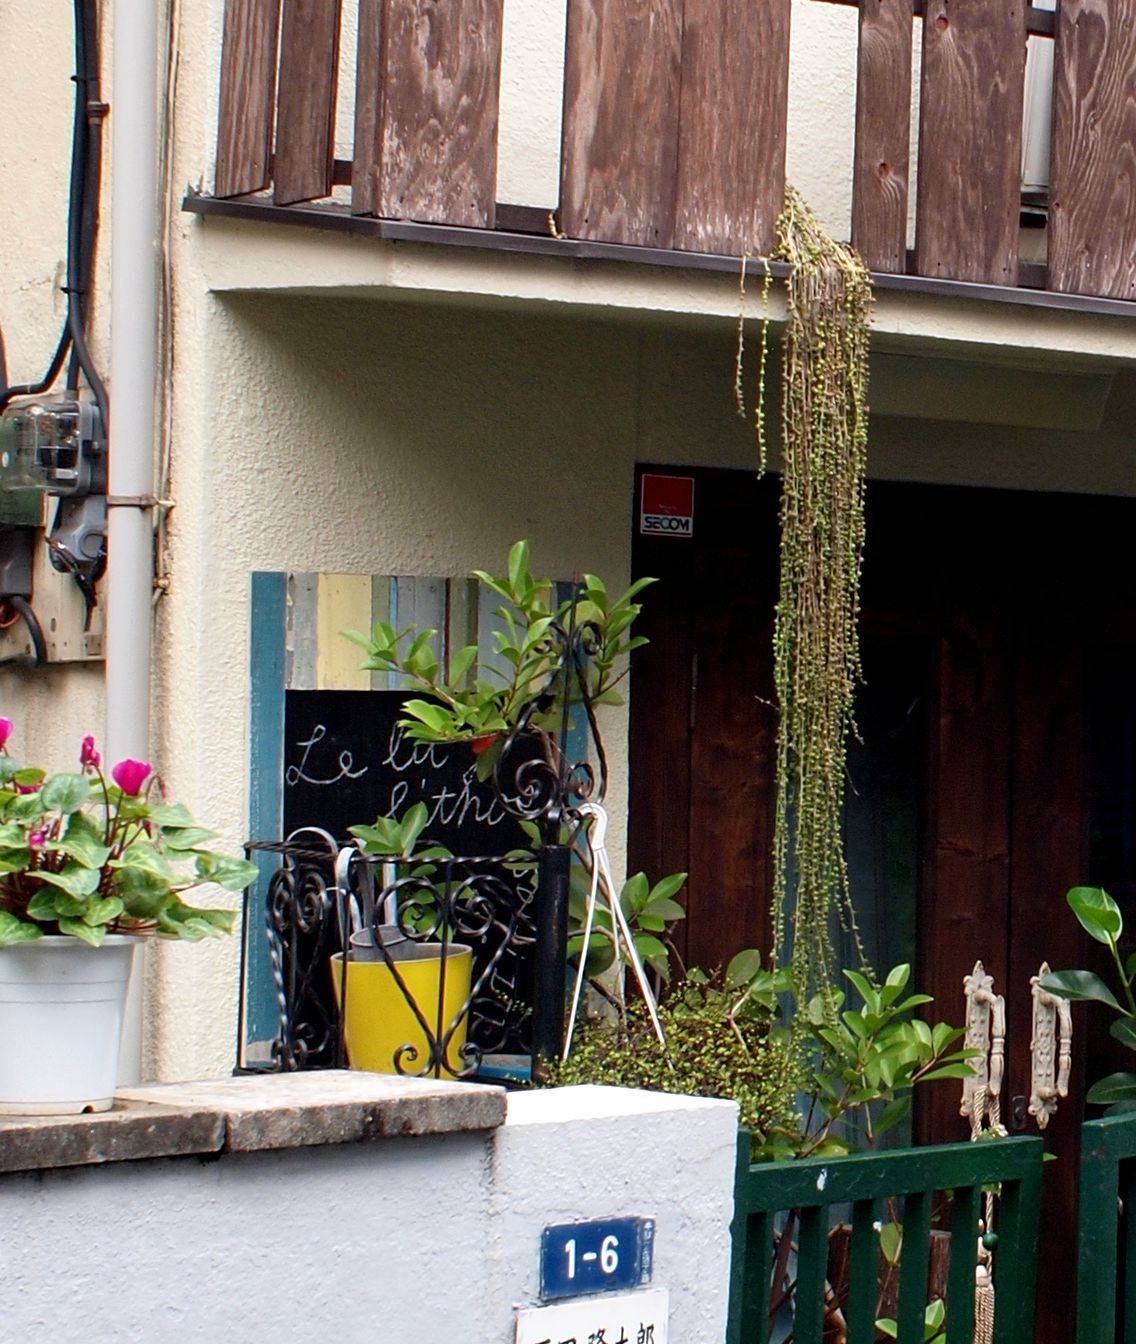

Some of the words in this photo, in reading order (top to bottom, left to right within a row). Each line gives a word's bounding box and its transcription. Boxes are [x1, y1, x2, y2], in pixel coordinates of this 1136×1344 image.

[644, 516, 690, 531] SECOM
[286, 724, 368, 786] Le
[564, 1235, 619, 1279] 1-6
